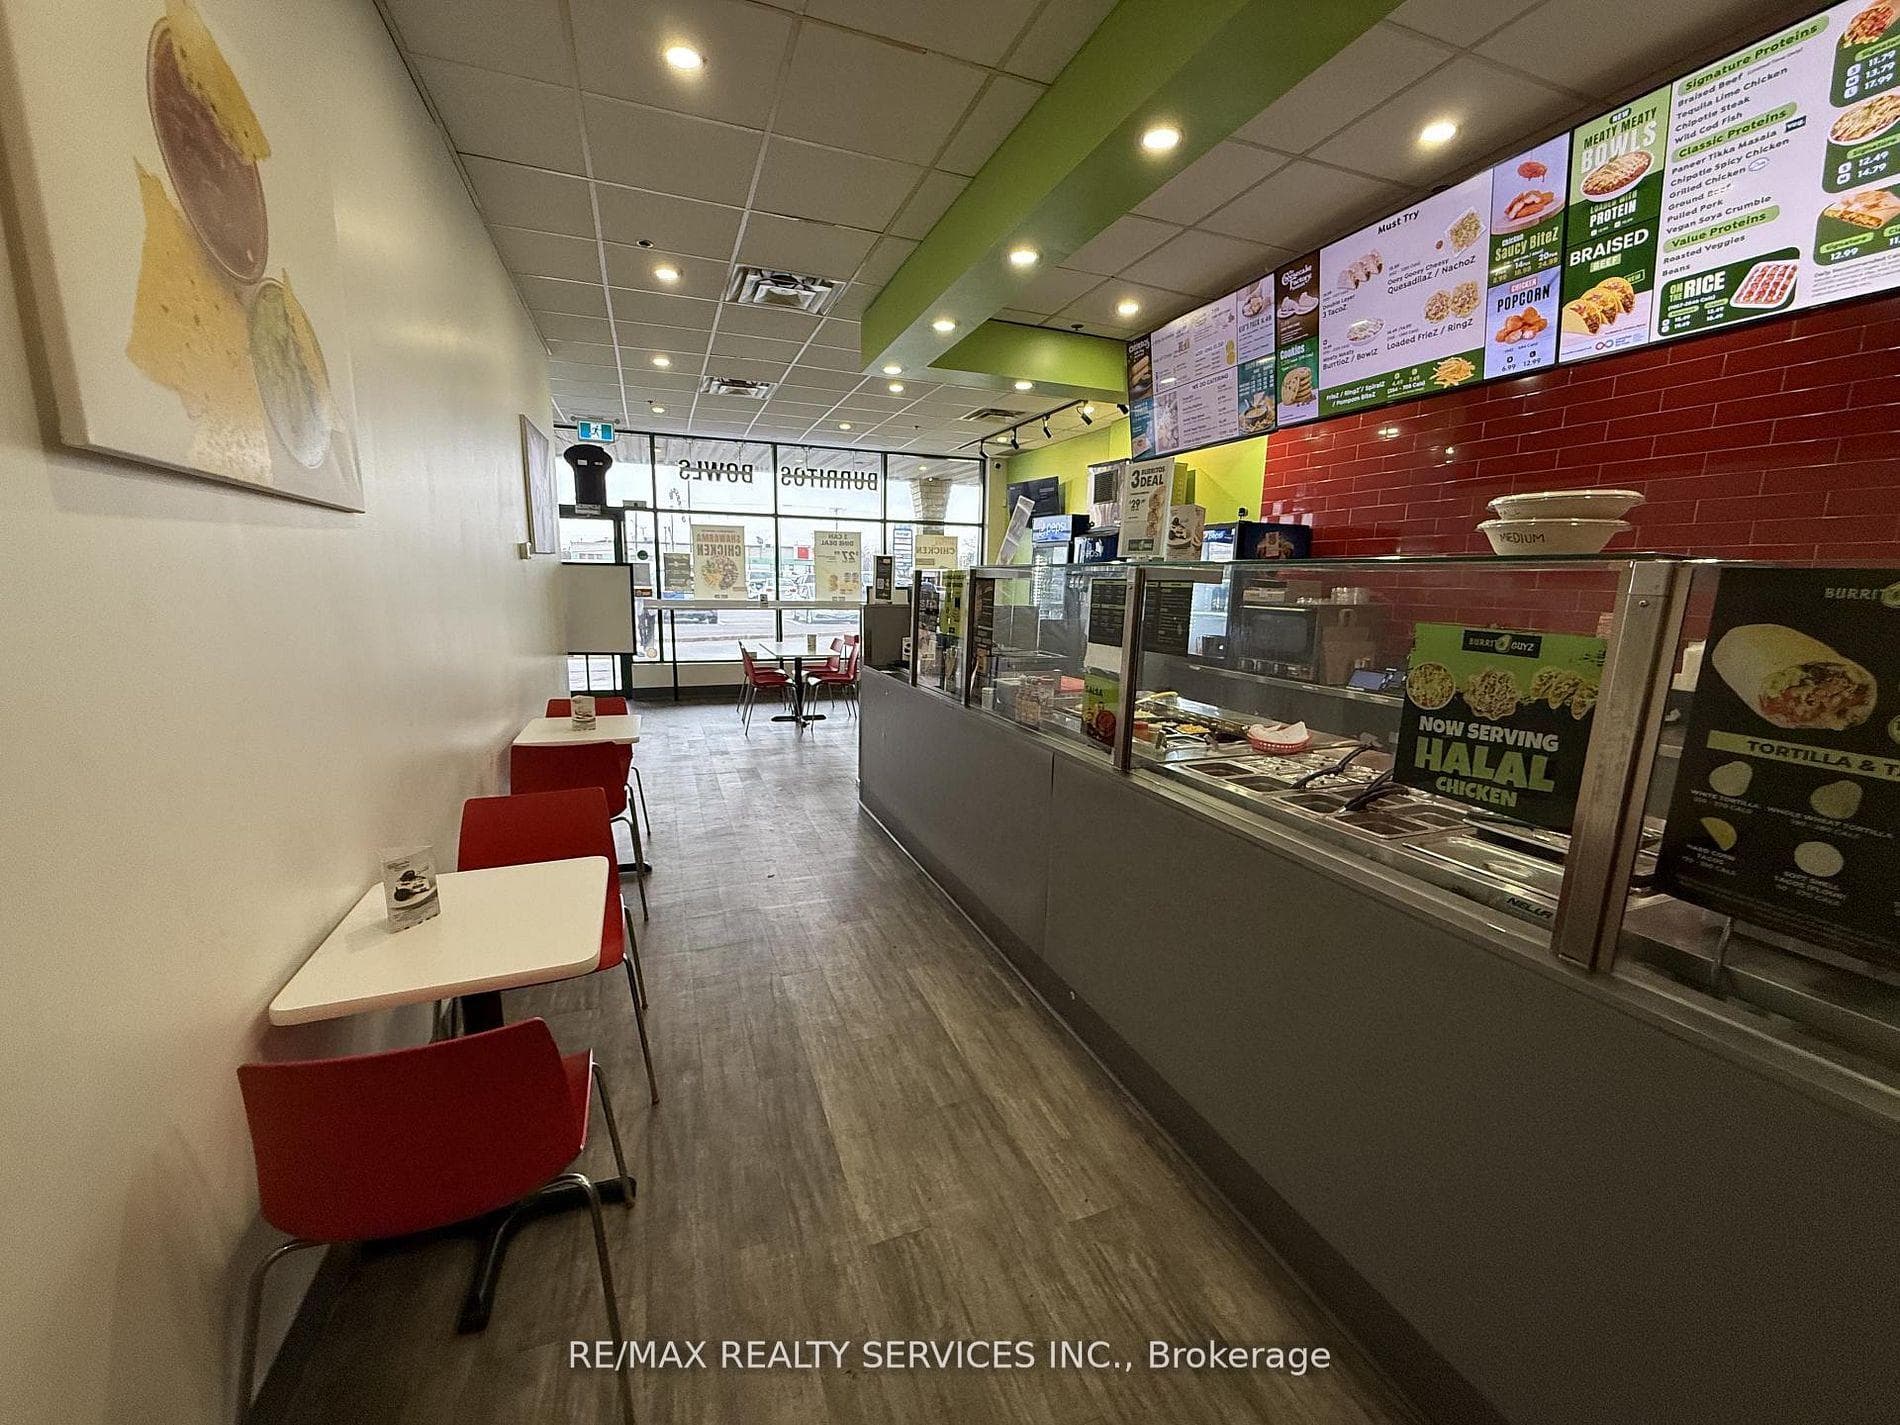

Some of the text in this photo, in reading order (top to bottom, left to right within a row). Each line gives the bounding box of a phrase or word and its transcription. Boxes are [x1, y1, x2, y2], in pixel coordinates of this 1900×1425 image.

[1686, 56, 1751, 91] Signature
[1754, 24, 1818, 59] Proteins
[1676, 67, 1788, 120] Tequila Lime Chicken
[1677, 72, 1744, 107] Braised Beef
[1584, 107, 1658, 150] MEATY MEATY
[1674, 111, 1743, 144] Wild Cod Fish
[1675, 96, 1751, 132] Chipotle Steak
[1581, 120, 1658, 174] BOWLS
[1678, 109, 1787, 158] Classic Proteins
[1671, 156, 1706, 175] Paneer
[1708, 145, 1736, 160] Tikka
[1738, 130, 1777, 150] Masala
[1714, 155, 1743, 171] Spicy
[1745, 138, 1790, 159] Chicken
[1669, 167, 1746, 199] Grilled Chicken
[1589, 199, 1638, 228] PROTEIN
[1665, 195, 1772, 235] Vegan Soya Crumble
[1667, 199, 1724, 223] Pulled Pork
[1668, 193, 1704, 211] Ground
[1377, 209, 1420, 235] Must Try
[1671, 211, 1767, 248] Value Proteins
[1495, 240, 1528, 262] Saucy
[1529, 226, 1559, 249] BiteZ
[1569, 228, 1649, 267] BRAISED
[1663, 235, 1746, 264] Roasted Veggies
[1830, 247, 1858, 261] 12.99
[1442, 255, 1476, 275] NachoZ
[1661, 264, 1690, 277] Beans
[1497, 284, 1551, 313] POPCORN
[1510, 278, 1537, 293] CHICKEN
[1683, 270, 1726, 300] RICE
[1328, 304, 1348, 317] TacoZ
[1386, 335, 1415, 351] Loaded
[1417, 328, 1439, 341] FrieZ
[1447, 318, 1473, 332] RingZ
[1356, 348, 1379, 360] BowlZ
[1131, 469, 1141, 489] 3
[1140, 474, 1165, 487] DEAL
[1499, 531, 1545, 544] MEDIUM
[1418, 715, 1559, 752] NOW SERVING
[1414, 736, 1555, 793] HALAL
[1746, 740, 1852, 770] TORTILLA
[1435, 776, 1518, 808] CHICKEN
